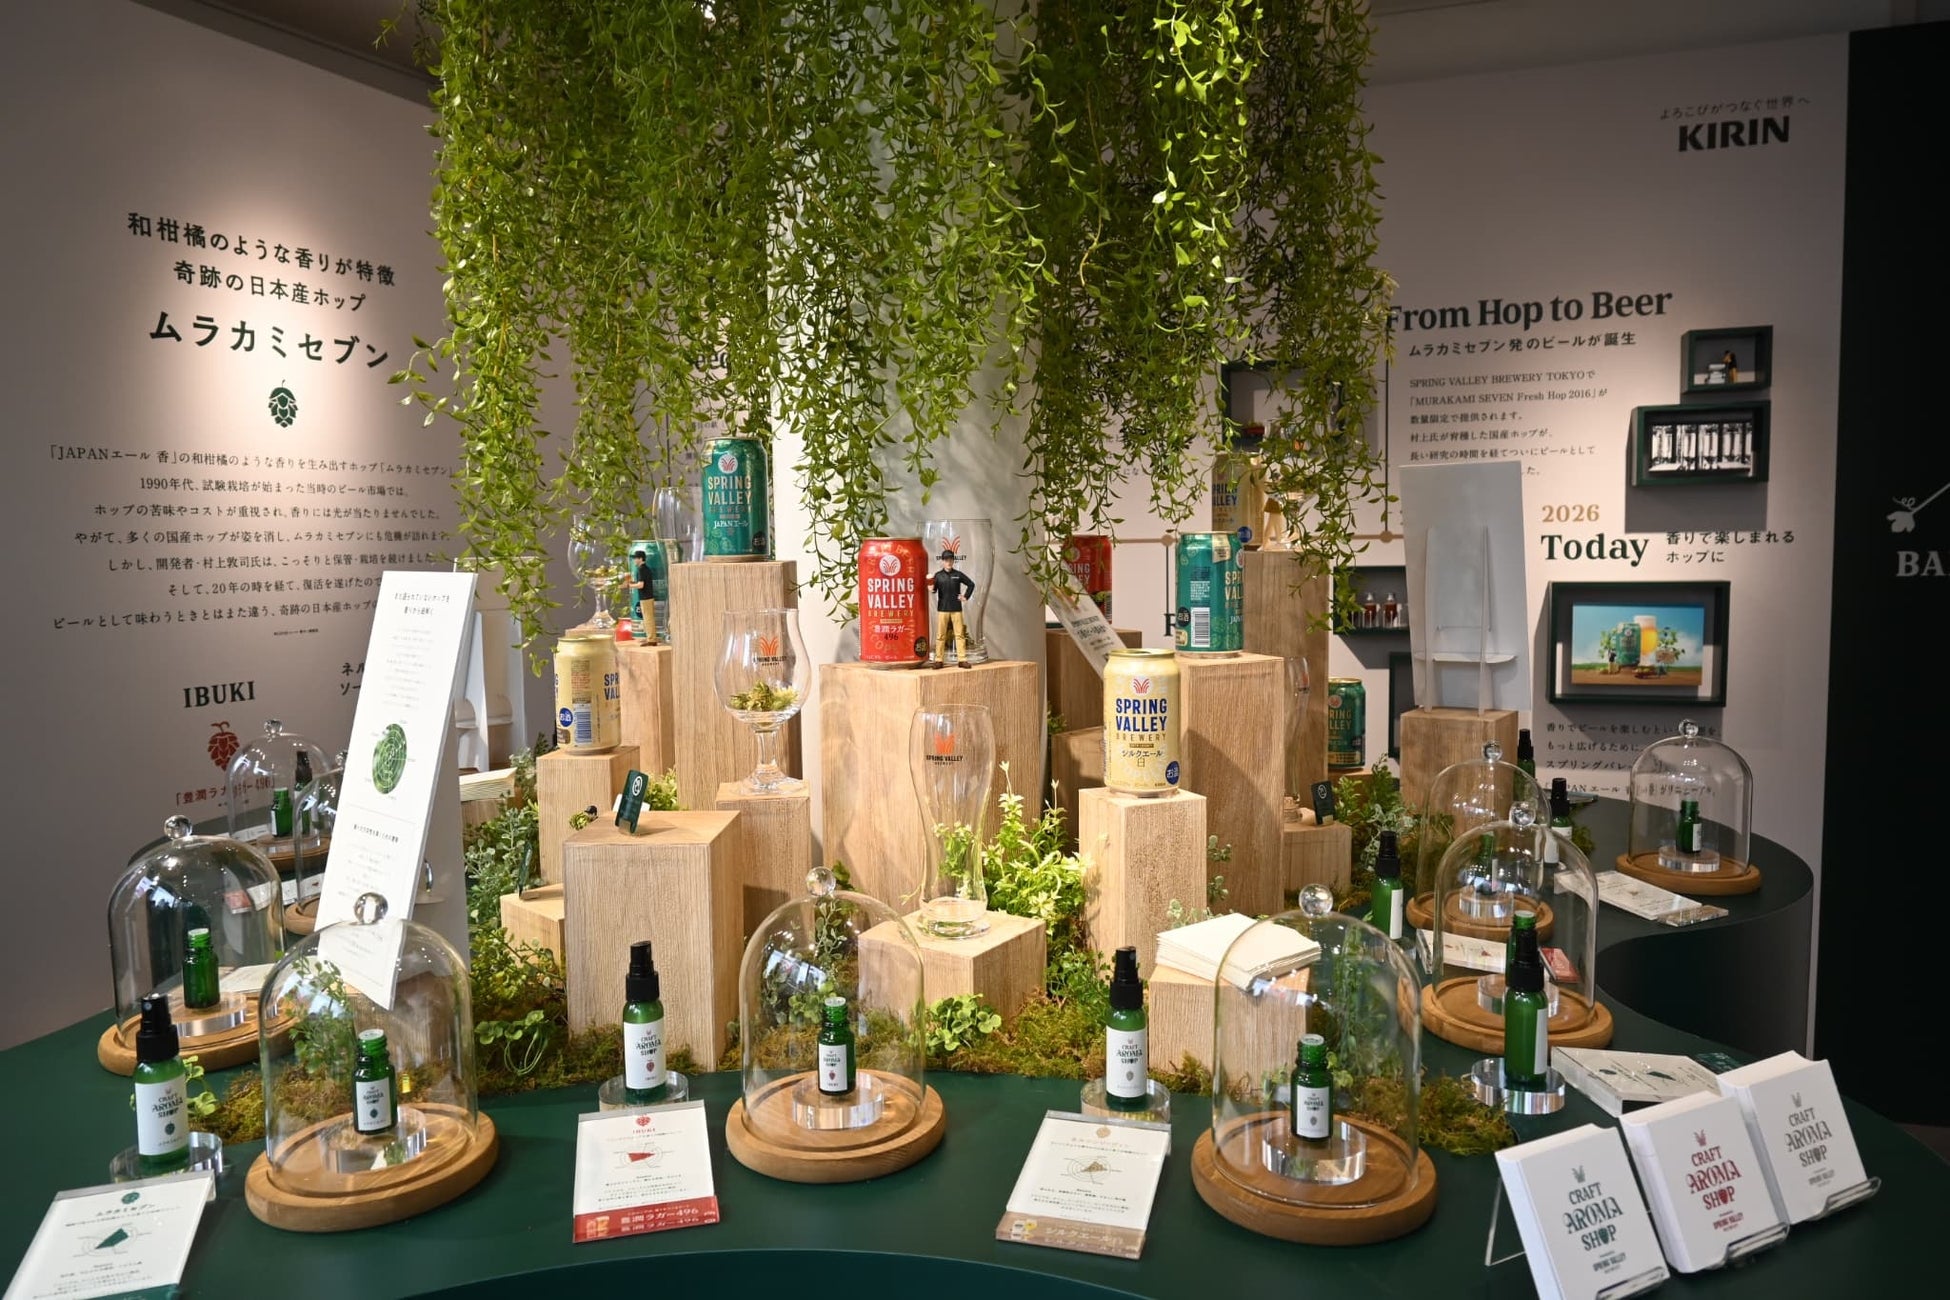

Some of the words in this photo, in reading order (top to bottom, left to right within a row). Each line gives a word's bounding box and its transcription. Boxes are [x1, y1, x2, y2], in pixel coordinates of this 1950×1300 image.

[1660, 96, 1811, 120] よろこびがつなぐ世界へ
[1678, 115, 1790, 152] KIRIN
[128, 212, 395, 287] 和柑橘のような香りが特徴
[173, 260, 366, 311] 奇跡の日本産ホップ
[1386, 305, 1471, 331] From
[1478, 298, 1544, 331] Hop
[1549, 296, 1583, 321] to
[1591, 291, 1673, 319] Beer
[150, 311, 389, 368] ムラカミセブン
[1409, 331, 1636, 357] ムラカミセブン発のビールが誕生
[1409, 378, 1446, 388] SPRING
[1448, 375, 1488, 386] VALLEY
[1491, 372, 1543, 384] BREWERY
[1546, 370, 1596, 382] TOKYOで
[1409, 395, 1476, 407] 「MURAKAMI
[1478, 392, 1514, 403] SEVEN
[1517, 390, 1545, 402] Fresh
[1547, 390, 1567, 401] Hop
[1410, 411, 1522, 424] 数量限定で提供されます。
[1410, 446, 1596, 461] 長い研究の時間を経てついにビールとして
[708, 476, 752, 490] SPRING
[708, 491, 753, 505] VALLEY
[1541, 504, 1600, 523] 2026
[1666, 530, 1795, 545] 香りで楽しまれる
[1540, 533, 1650, 567] Today
[1666, 550, 1725, 563] ホップに
[109, 554, 436, 571] しかし、開発者・村上敦司氏は、こっそりと保管・栽培を続けました
[1896, 551, 1950, 577] BA
[867, 577, 914, 592] SPRING
[867, 594, 915, 609] VALLEY
[884, 633, 899, 641] 496
[183, 681, 255, 708] IBUKI
[1116, 698, 1167, 714] SPRING
[1116, 716, 1167, 732] VALLEY
[1116, 733, 1166, 741] BREWERY
[1122, 750, 1163, 758] シルクエール
[1788, 1107, 1816, 1127] CRAFT
[1785, 1120, 1832, 1152] AROMA
[1691, 1146, 1722, 1166] CRAFT
[1685, 1160, 1742, 1194] AROMA
[1569, 1182, 1602, 1205] CRAFT
[1563, 1197, 1623, 1234] AROMA
